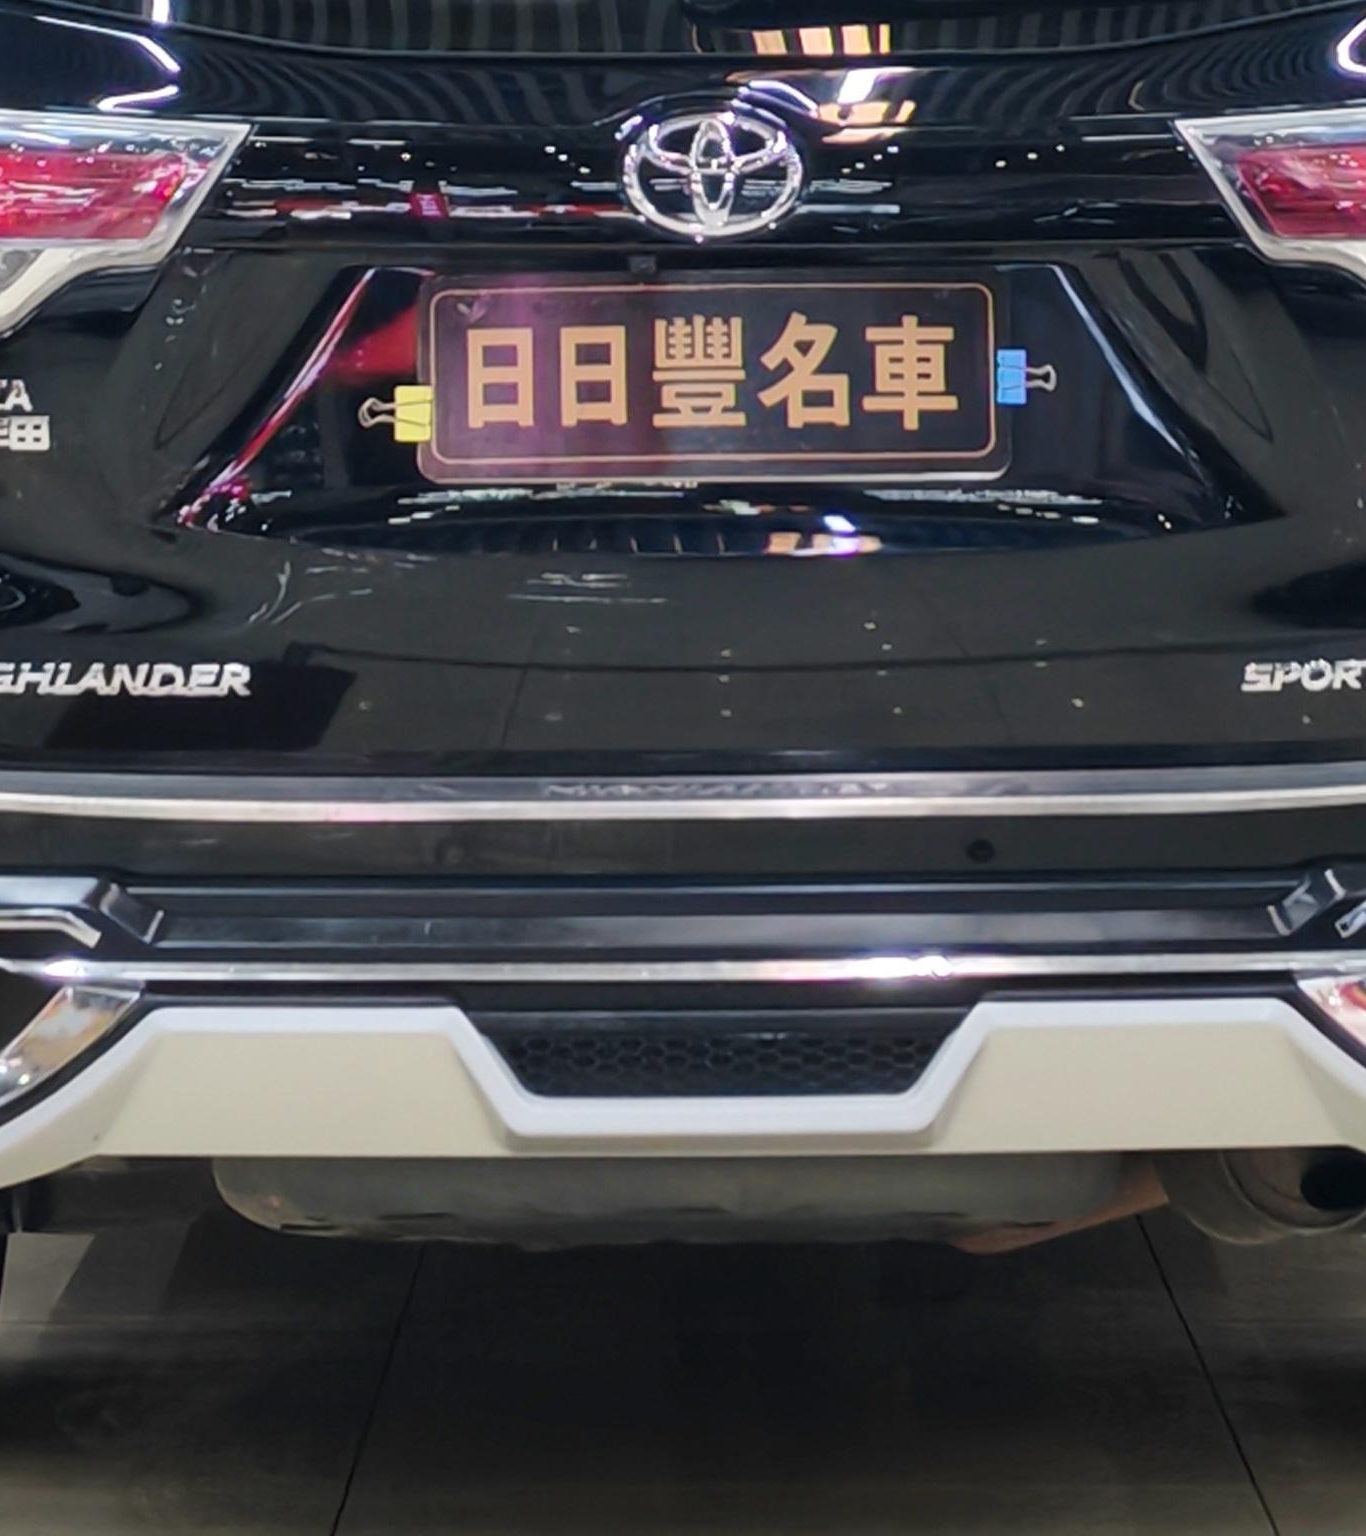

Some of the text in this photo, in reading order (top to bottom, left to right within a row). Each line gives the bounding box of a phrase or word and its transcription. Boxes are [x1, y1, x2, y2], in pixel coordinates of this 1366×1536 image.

[466, 312, 958, 432] 日日豐名車
